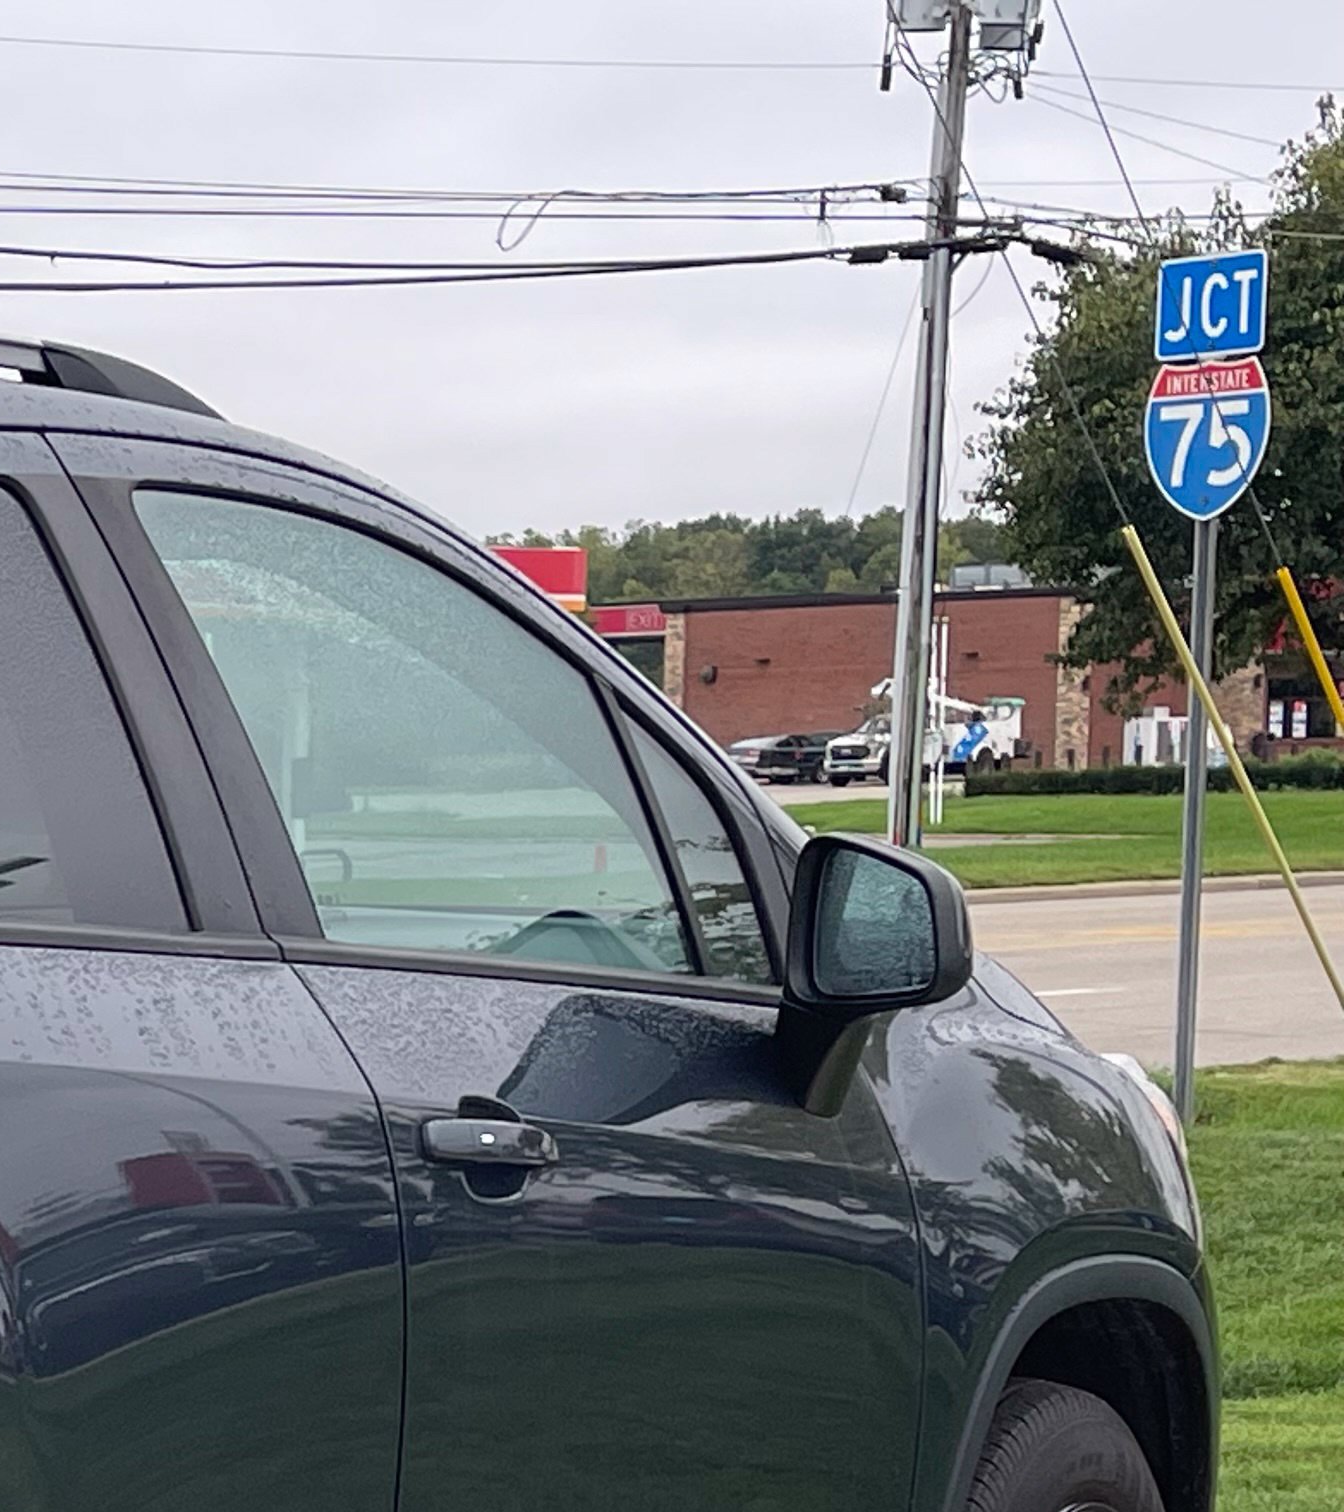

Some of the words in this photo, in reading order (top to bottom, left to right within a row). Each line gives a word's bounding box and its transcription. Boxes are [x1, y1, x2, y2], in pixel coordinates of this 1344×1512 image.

[1164, 269, 1258, 342] JCT
[1166, 368, 1251, 394] INTERSTATE
[1160, 400, 1252, 488] 75
